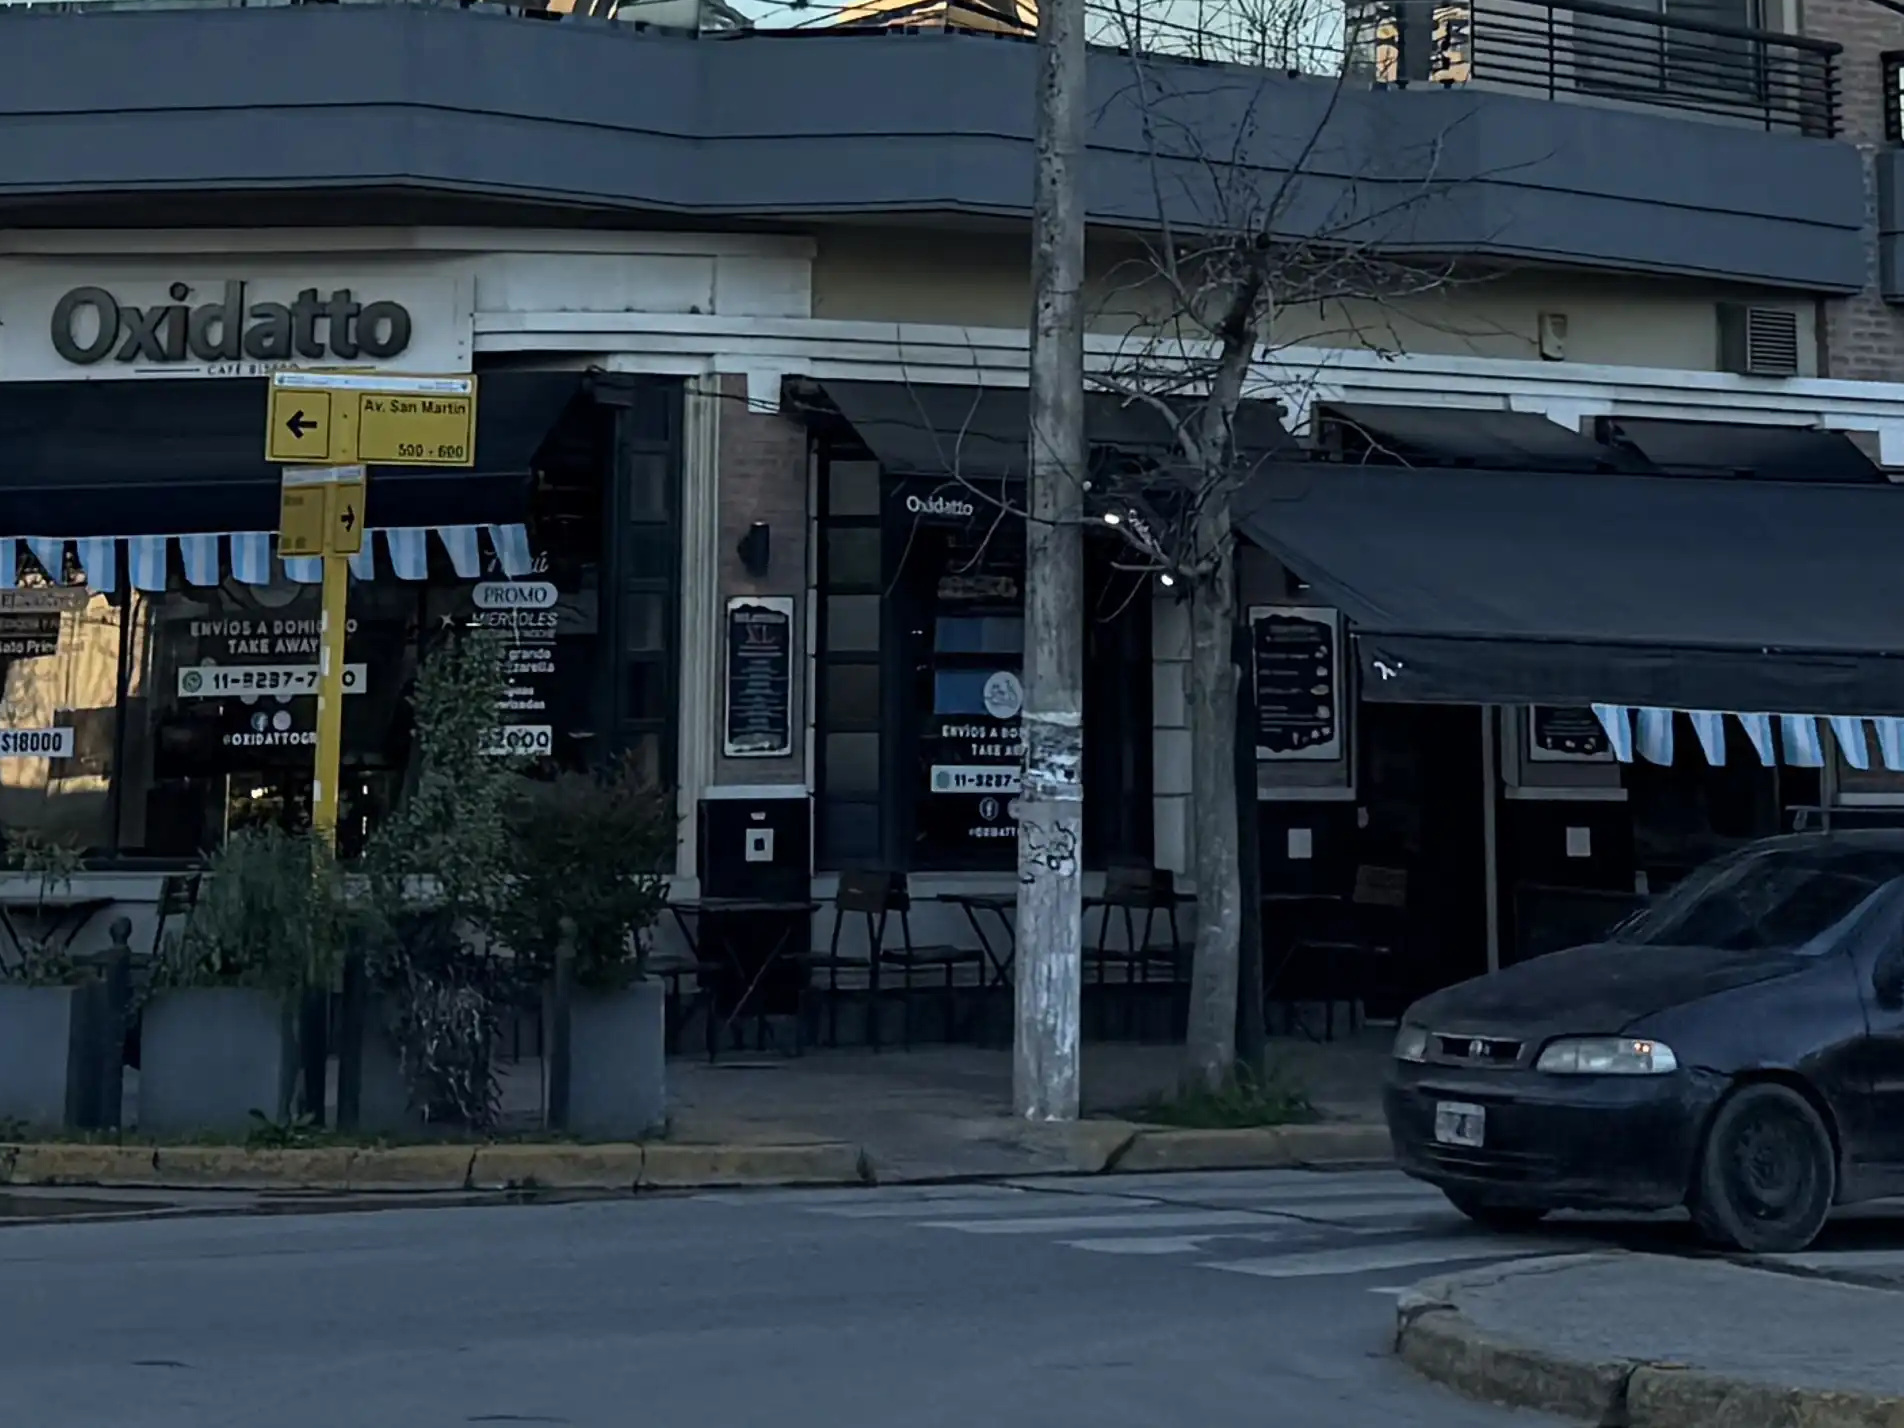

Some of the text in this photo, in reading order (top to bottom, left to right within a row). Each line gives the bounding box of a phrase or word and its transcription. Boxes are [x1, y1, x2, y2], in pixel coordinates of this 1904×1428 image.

[50, 280, 413, 365] Oxidatto
[364, 400, 385, 413] Av.
[390, 400, 416, 414] San
[484, 587, 548, 604] PROMO
[257, 621, 268, 635] A
[228, 639, 270, 655] TAKE
[1, 733, 63, 752] $18000
